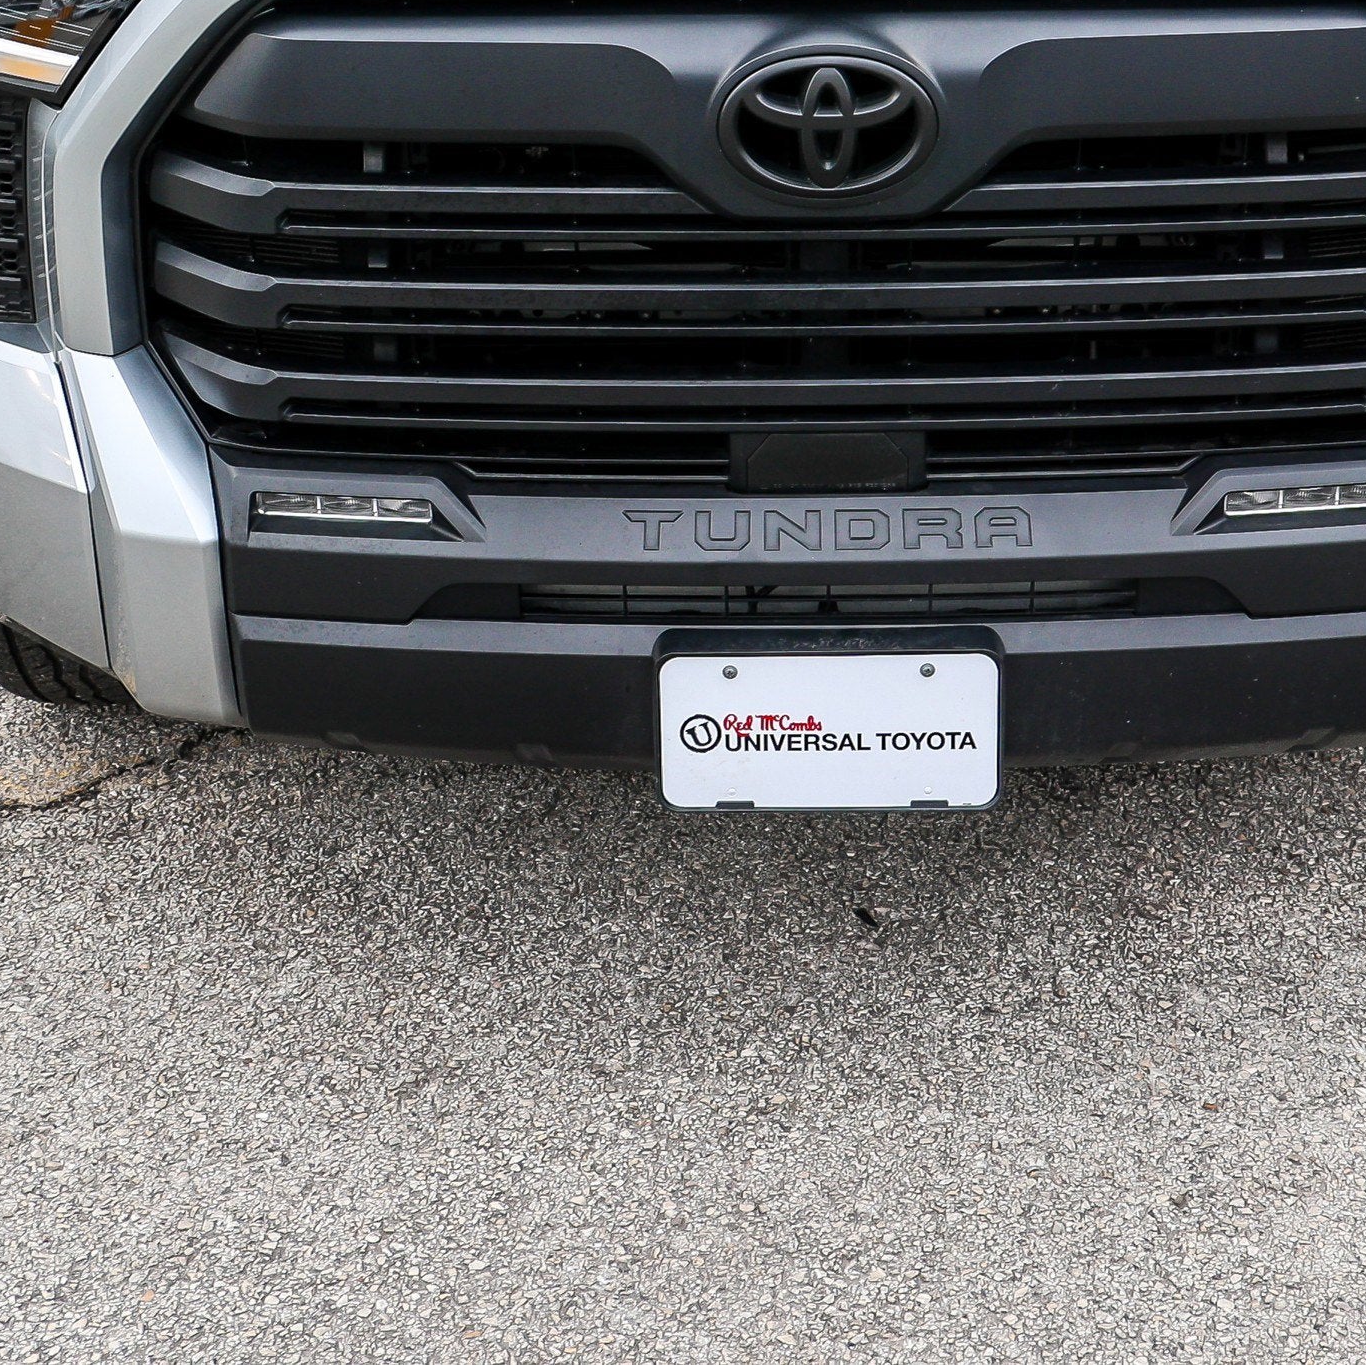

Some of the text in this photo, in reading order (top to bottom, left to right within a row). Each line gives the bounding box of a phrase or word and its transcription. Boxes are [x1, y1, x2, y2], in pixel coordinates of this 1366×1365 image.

[622, 506, 1033, 552] TUNDRA
[723, 713, 823, 734] Red McCombs
[724, 731, 977, 752] UNIVERSAL TOYOTA
